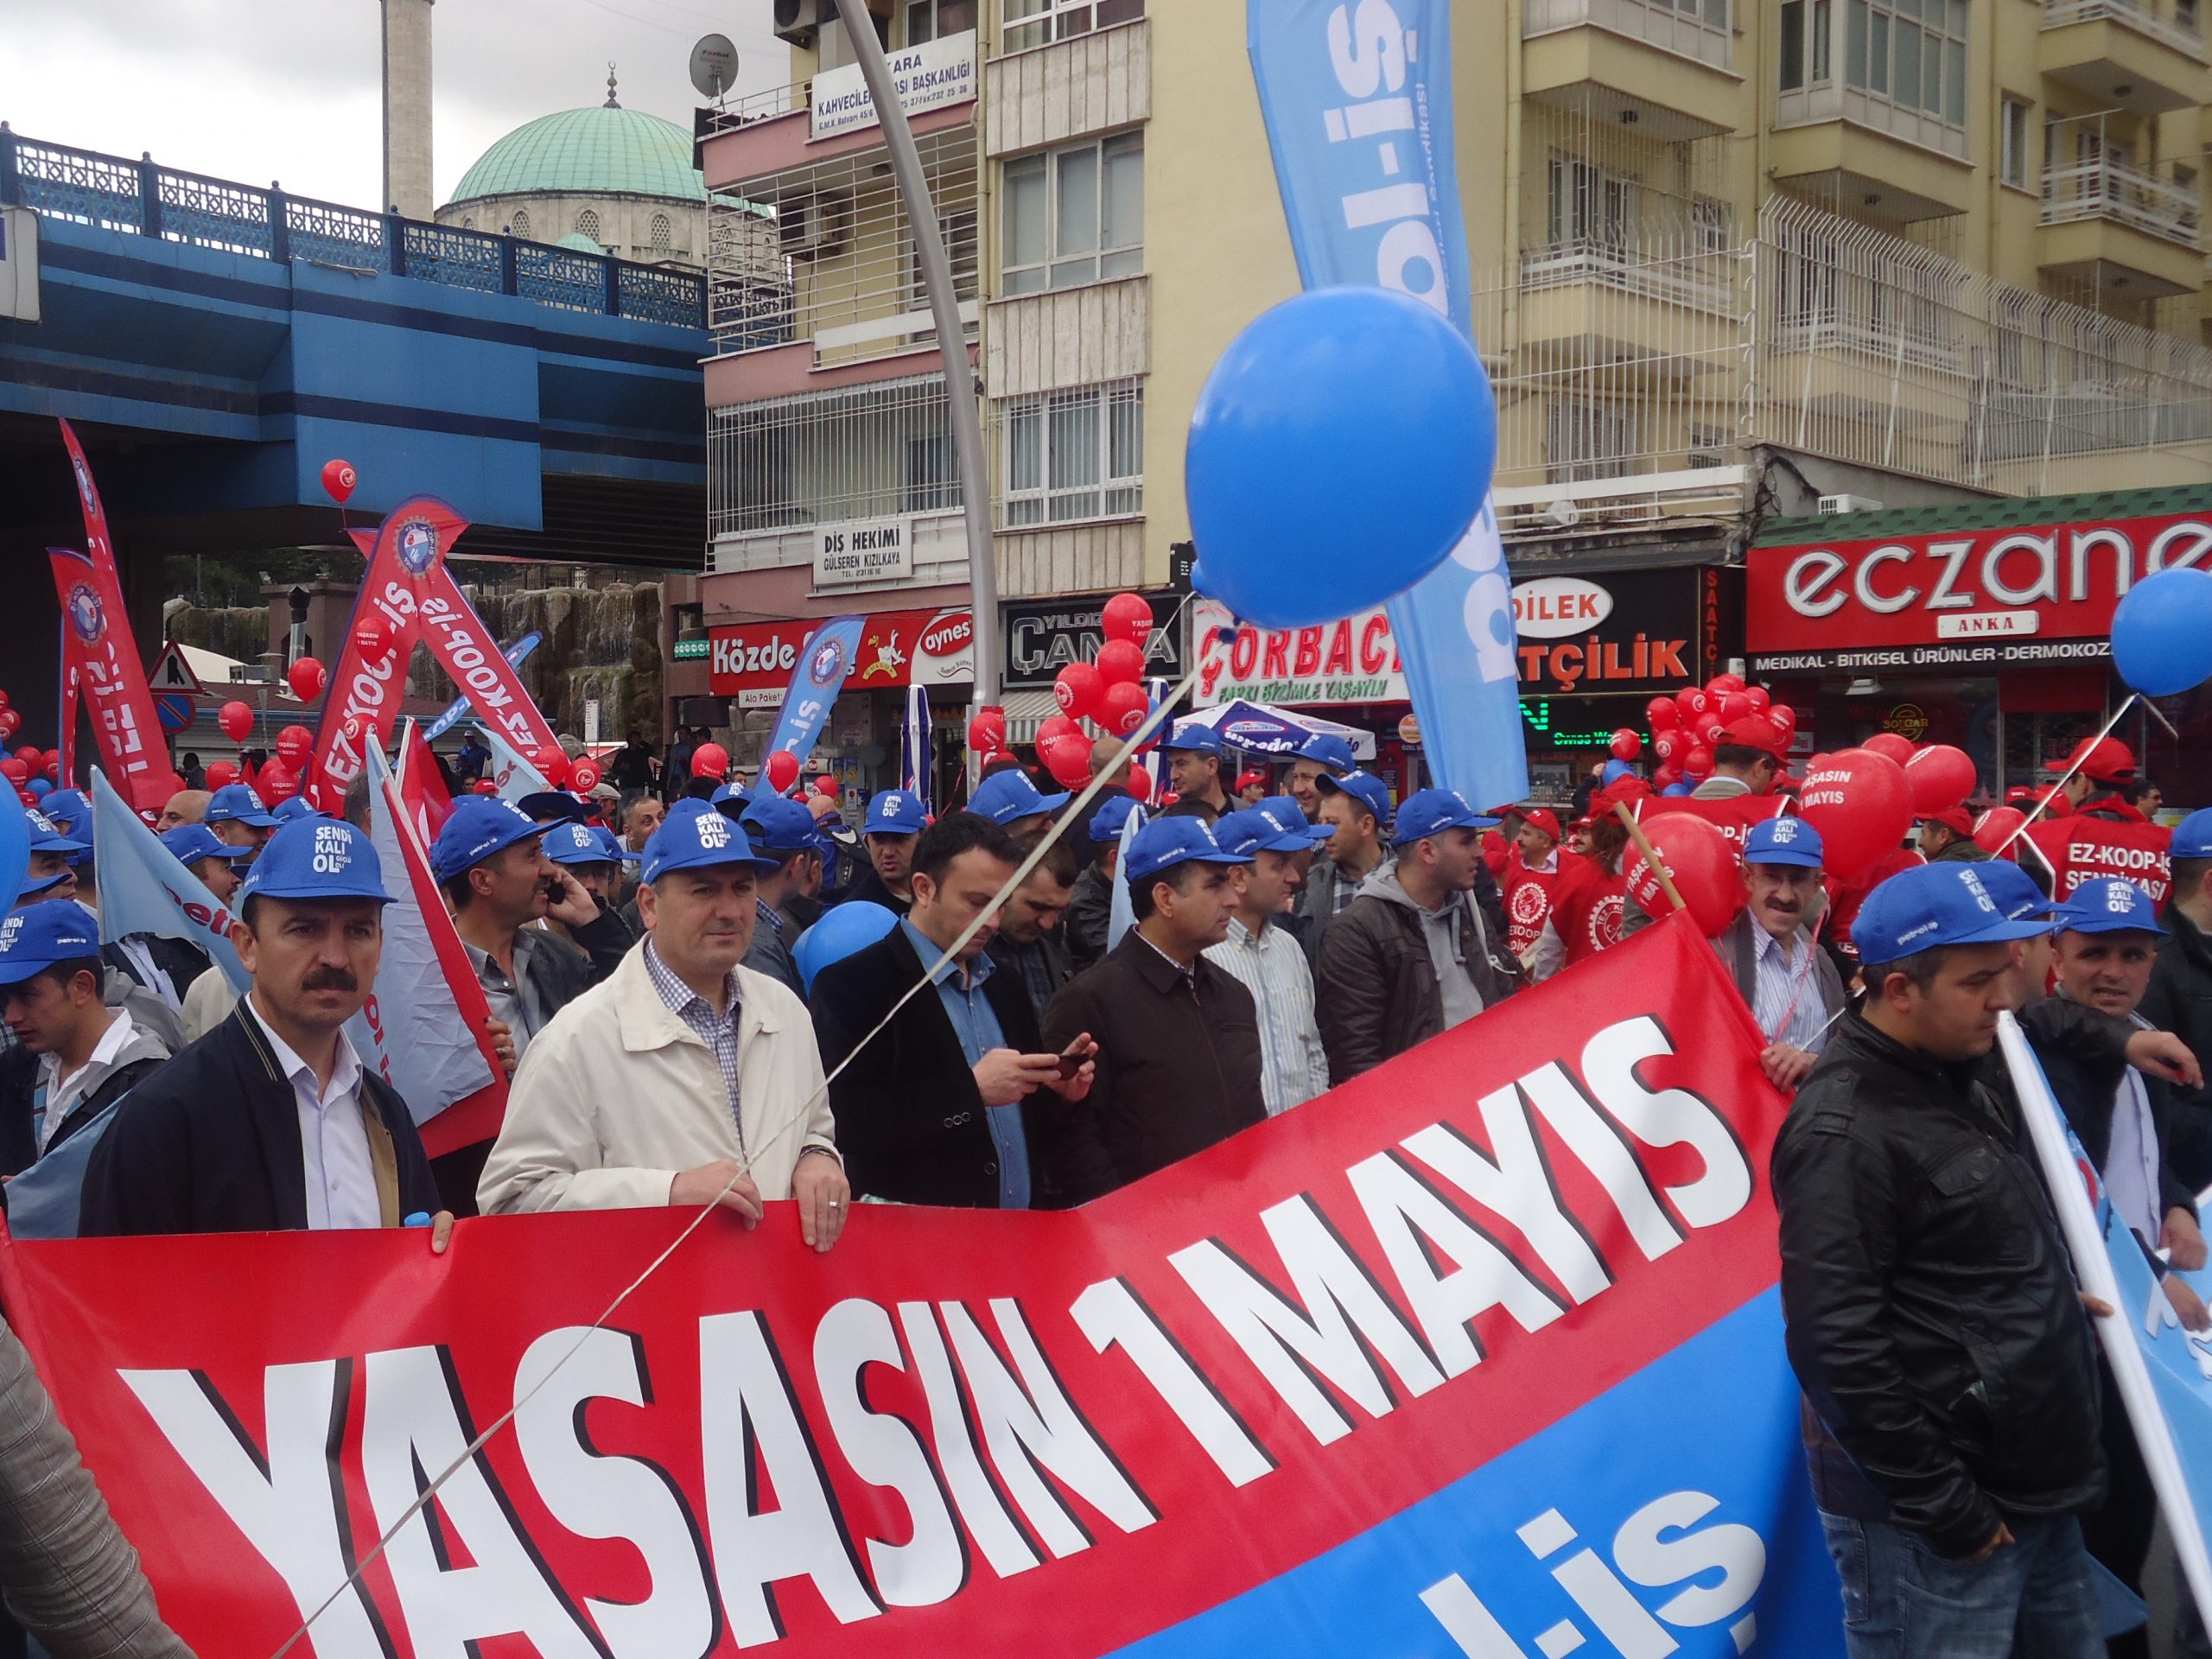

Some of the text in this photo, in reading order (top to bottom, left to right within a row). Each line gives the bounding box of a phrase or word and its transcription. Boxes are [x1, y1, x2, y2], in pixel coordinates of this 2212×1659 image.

[913, 60, 969, 92] BAŞKANLIĞI
[825, 524, 899, 554] DİŞ HEKİMİ
[1958, 616, 2015, 632] ANKA
[925, 621, 972, 652] aynes
[1012, 617, 1179, 675] ÇANA
[714, 636, 795, 673] Közde
[2005, 642, 2113, 660] DERMOKOZ
[1518, 631, 1688, 692] TÇİLİK
[1805, 791, 1845, 809] MAYIS
[697, 823, 724, 835] KALI
[1773, 833, 1789, 843] OL
[315, 842, 346, 855] KALI
[701, 835, 725, 849] OL
[313, 855, 340, 874] OL
[2107, 900, 2130, 913] OL
[1166, 1010, 1757, 1448] MAYIS
[1068, 1274, 1281, 1488] 1
